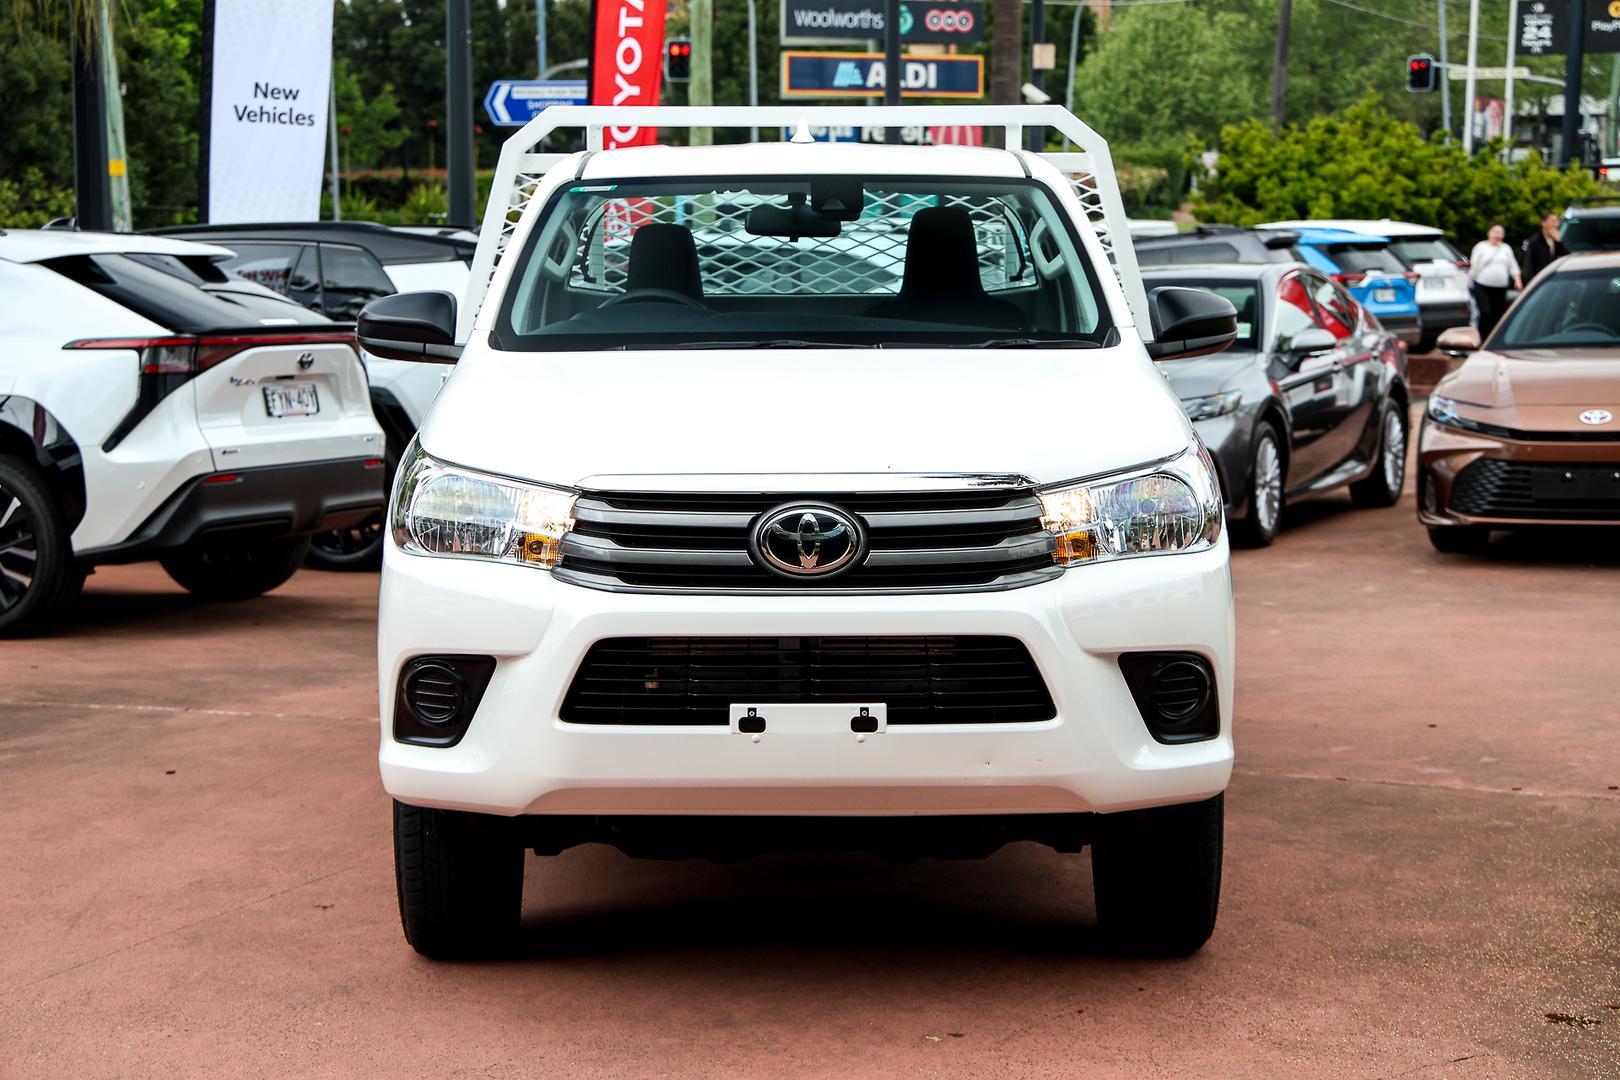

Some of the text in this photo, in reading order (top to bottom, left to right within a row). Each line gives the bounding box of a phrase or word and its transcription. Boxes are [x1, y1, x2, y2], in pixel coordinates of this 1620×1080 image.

[794, 8, 885, 29] Woolworths
[608, 0, 645, 150] YOT
[866, 62, 938, 89] ADI
[254, 82, 300, 100] New
[234, 104, 315, 126] Vehicles
